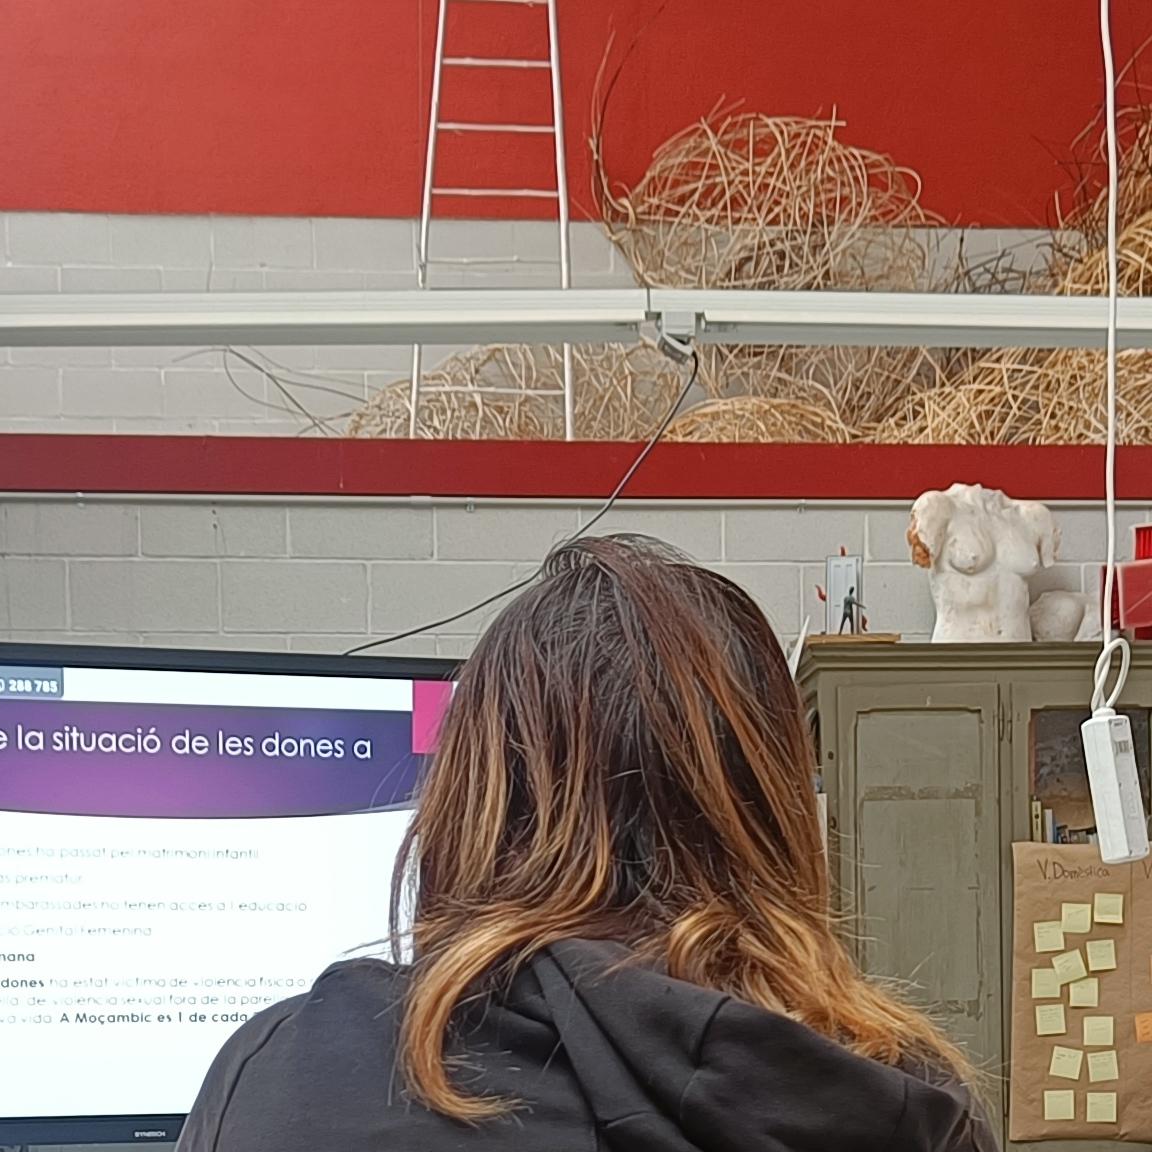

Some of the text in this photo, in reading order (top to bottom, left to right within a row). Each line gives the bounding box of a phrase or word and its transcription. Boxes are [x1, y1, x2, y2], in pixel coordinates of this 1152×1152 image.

[16, 724, 44, 750] la
[52, 725, 161, 753] situació
[171, 729, 209, 754] de
[218, 730, 254, 756] les
[261, 731, 345, 758] dones
[353, 739, 372, 759] a
[0, 977, 45, 989] dones
[59, 1012, 70, 1023] A
[74, 1011, 152, 1026] Moçambic
[188, 1011, 208, 1023] de
[211, 1011, 248, 1023] cada
